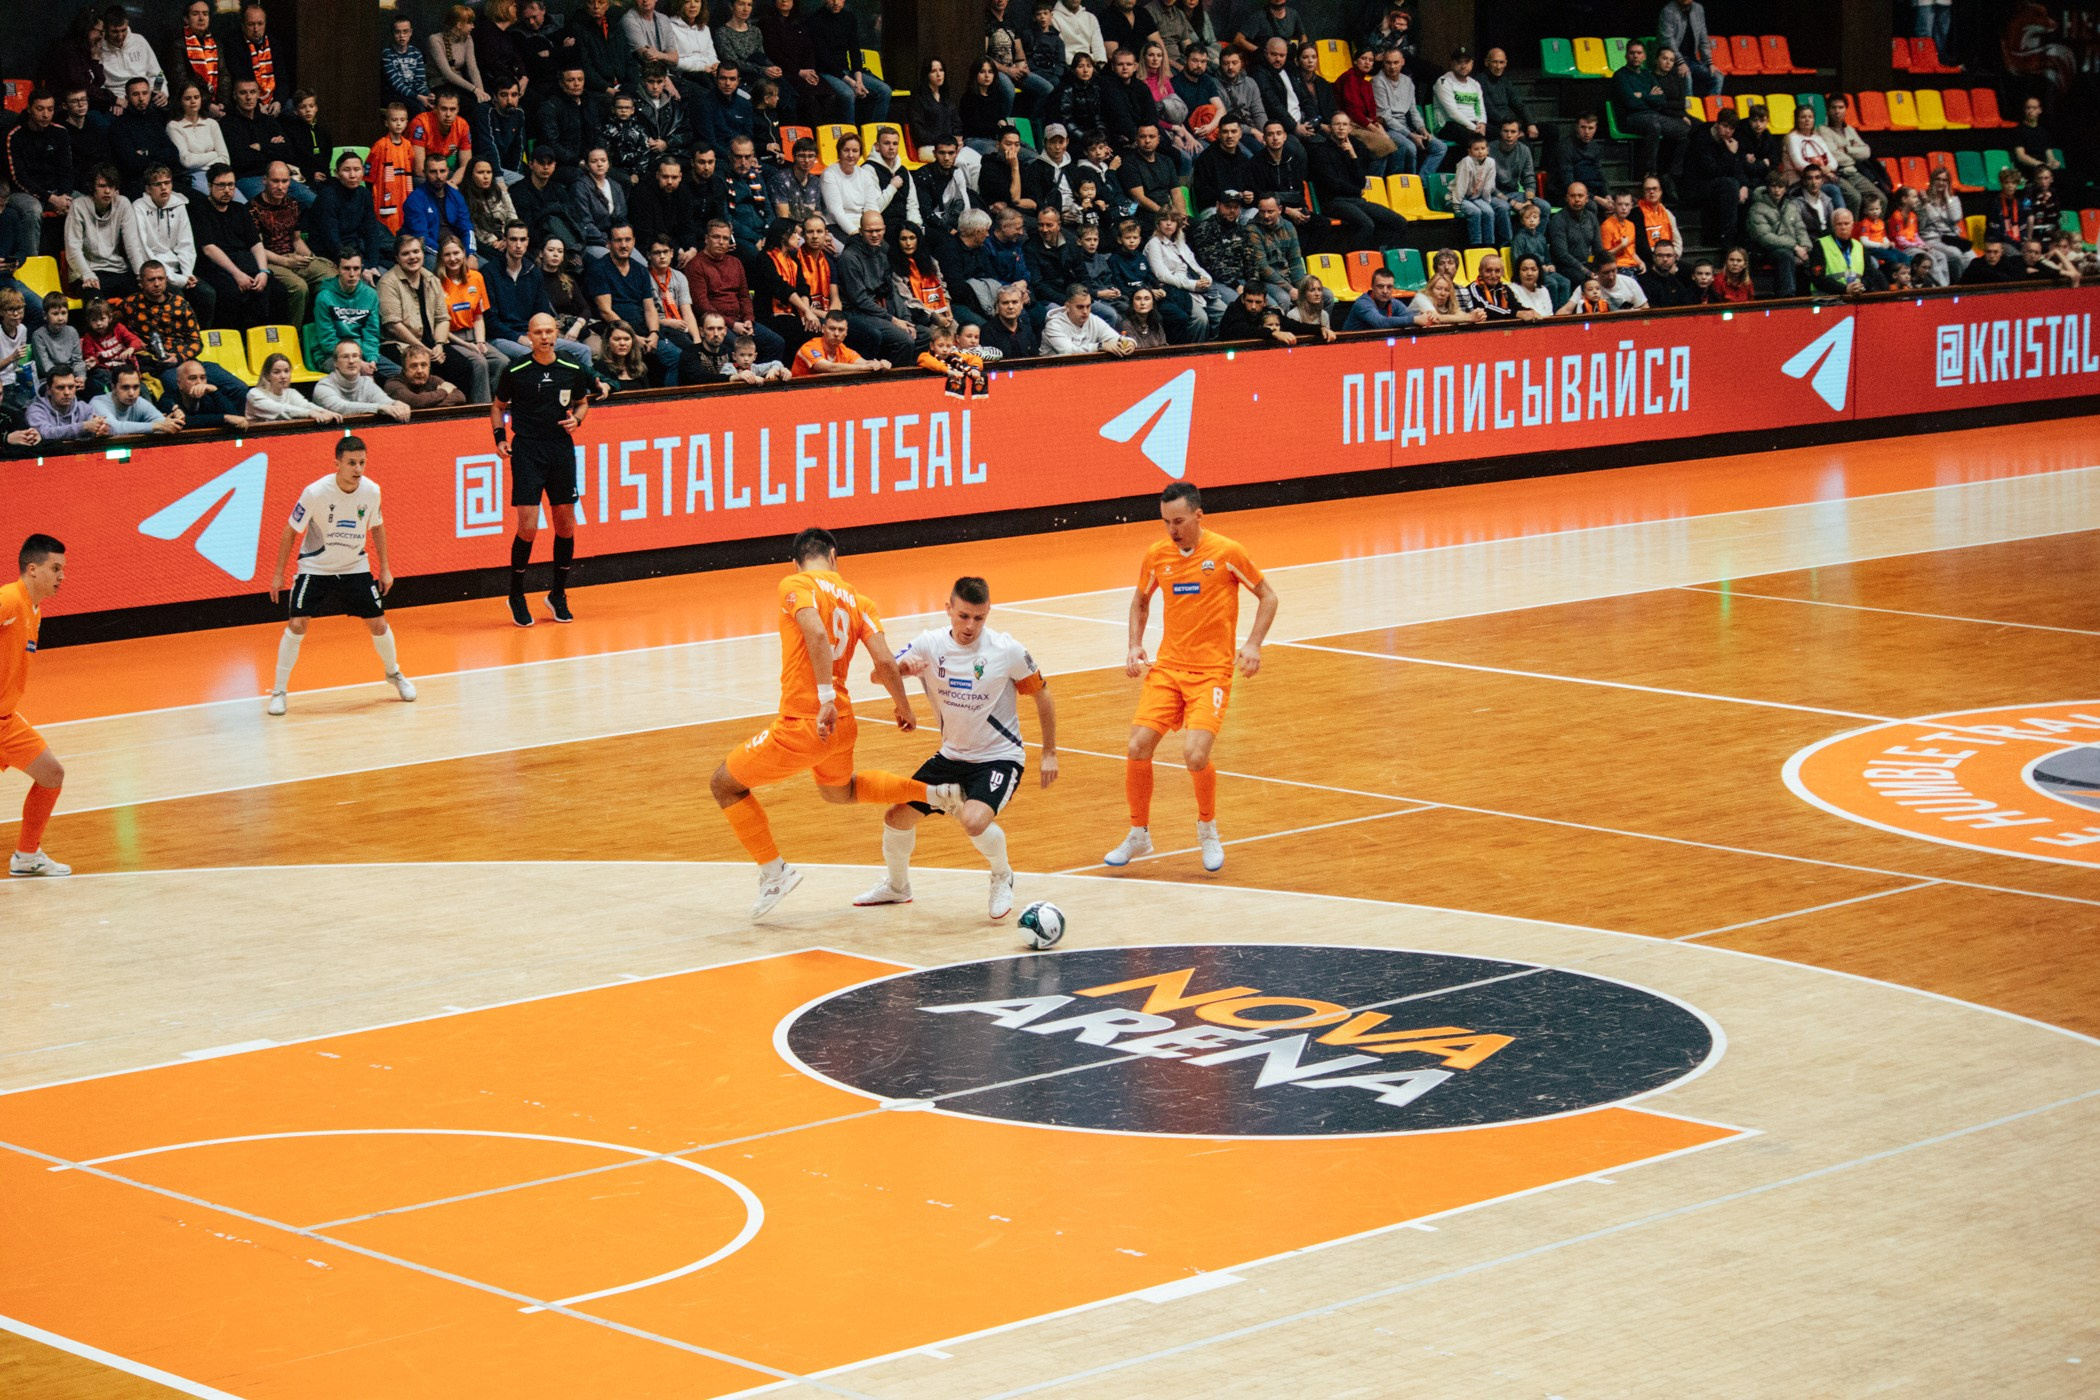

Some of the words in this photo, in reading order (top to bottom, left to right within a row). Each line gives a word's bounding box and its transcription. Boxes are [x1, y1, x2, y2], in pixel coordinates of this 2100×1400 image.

[1936, 313, 2100, 387] @KRISTAL
[1343, 340, 1690, 448] ПОДПИСЫВАЙСЯ
[456, 410, 987, 538] @ISTALLFUTSAL
[831, 607, 850, 661] 9
[938, 667, 946, 678] 10
[938, 688, 990, 701] ИНГОССТРАХ
[990, 770, 1005, 785] 10
[1861, 745, 2055, 829] HUMBLE
[915, 994, 1456, 1107] ARENA
[1074, 967, 1516, 1071] NOVA
